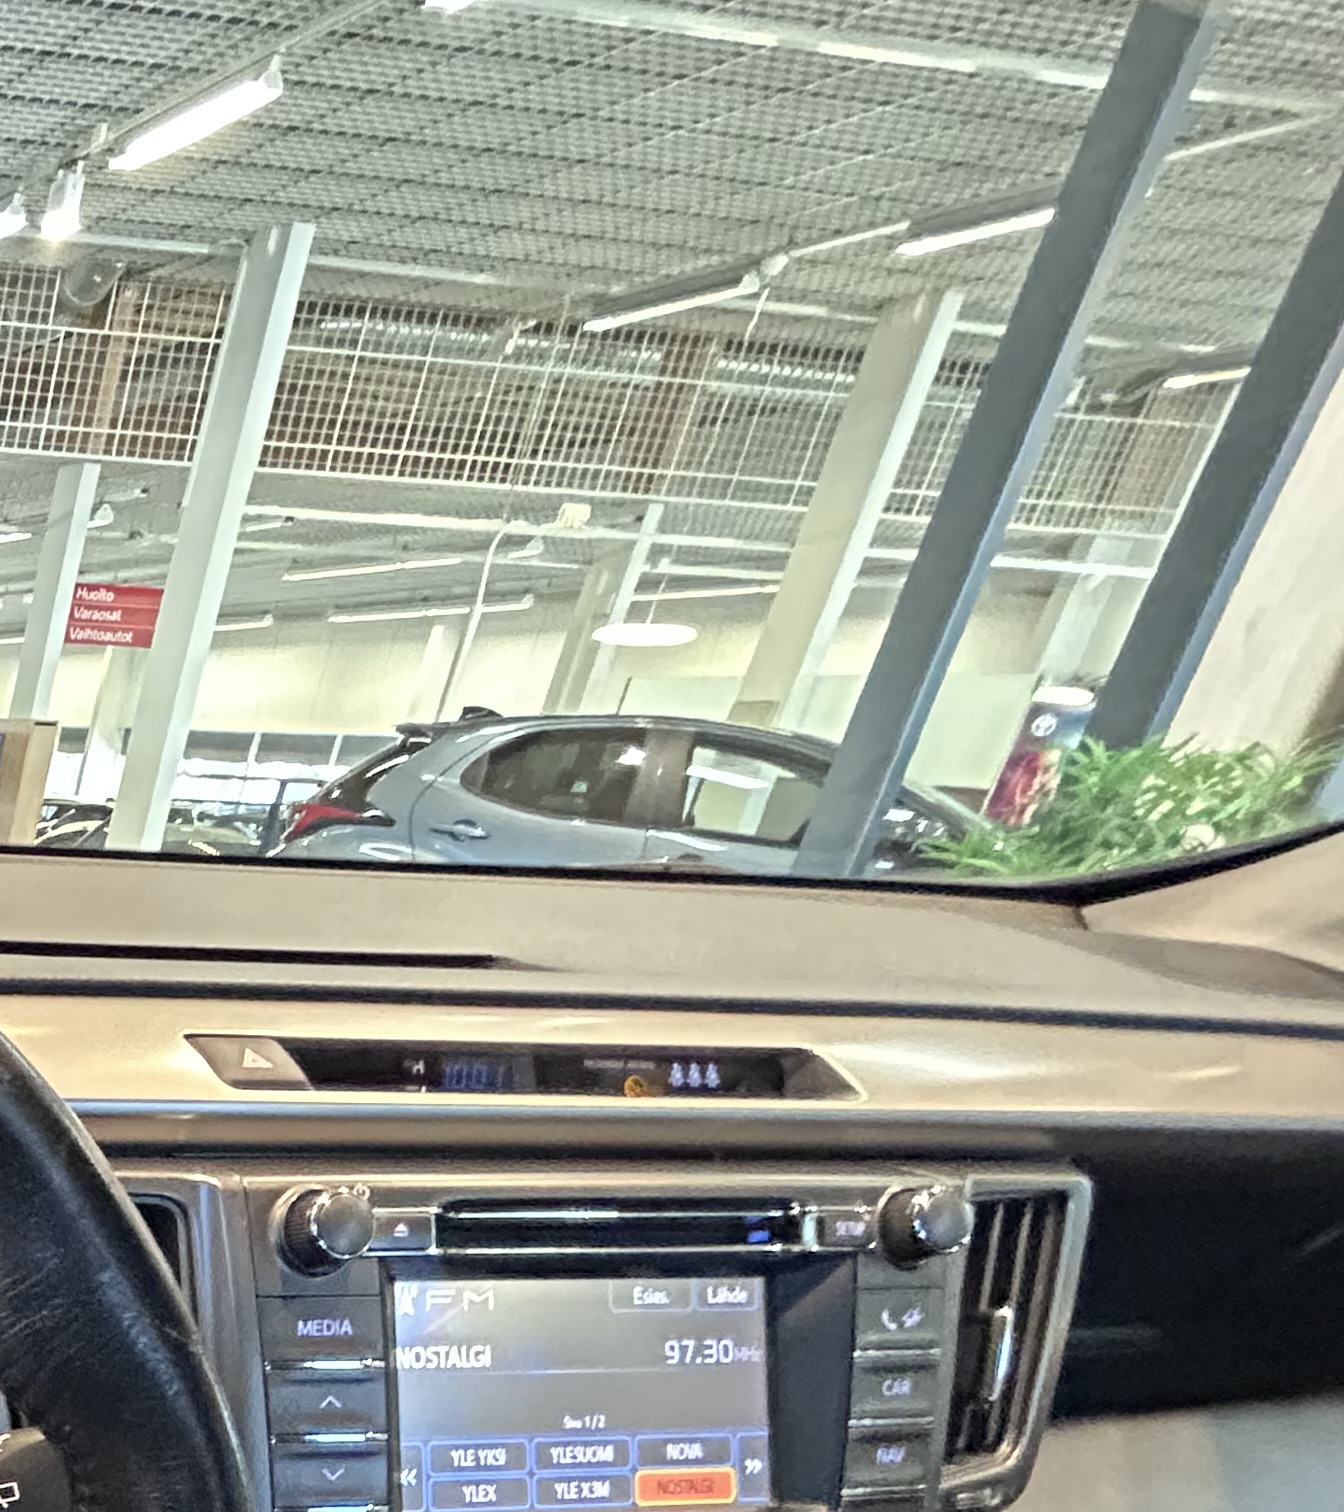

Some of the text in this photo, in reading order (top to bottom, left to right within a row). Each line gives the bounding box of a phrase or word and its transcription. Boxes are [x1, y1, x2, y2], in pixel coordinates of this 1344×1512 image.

[75, 586, 115, 602] Huolto
[73, 606, 122, 621] Varaosat
[69, 626, 134, 643] Vaihtoautot
[425, 1288, 495, 1312] FM
[296, 1318, 353, 1337] MEDIA
[396, 1344, 492, 1370] NOSTALGI
[664, 1338, 734, 1365] 97.30
[882, 1379, 911, 1396] CAR
[584, 1412, 607, 1430] 1/2
[451, 1448, 507, 1467] YLE YKSI
[666, 1442, 704, 1461] NOVA
[462, 1484, 497, 1503] YLEX
[555, 1481, 579, 1499] YLE
